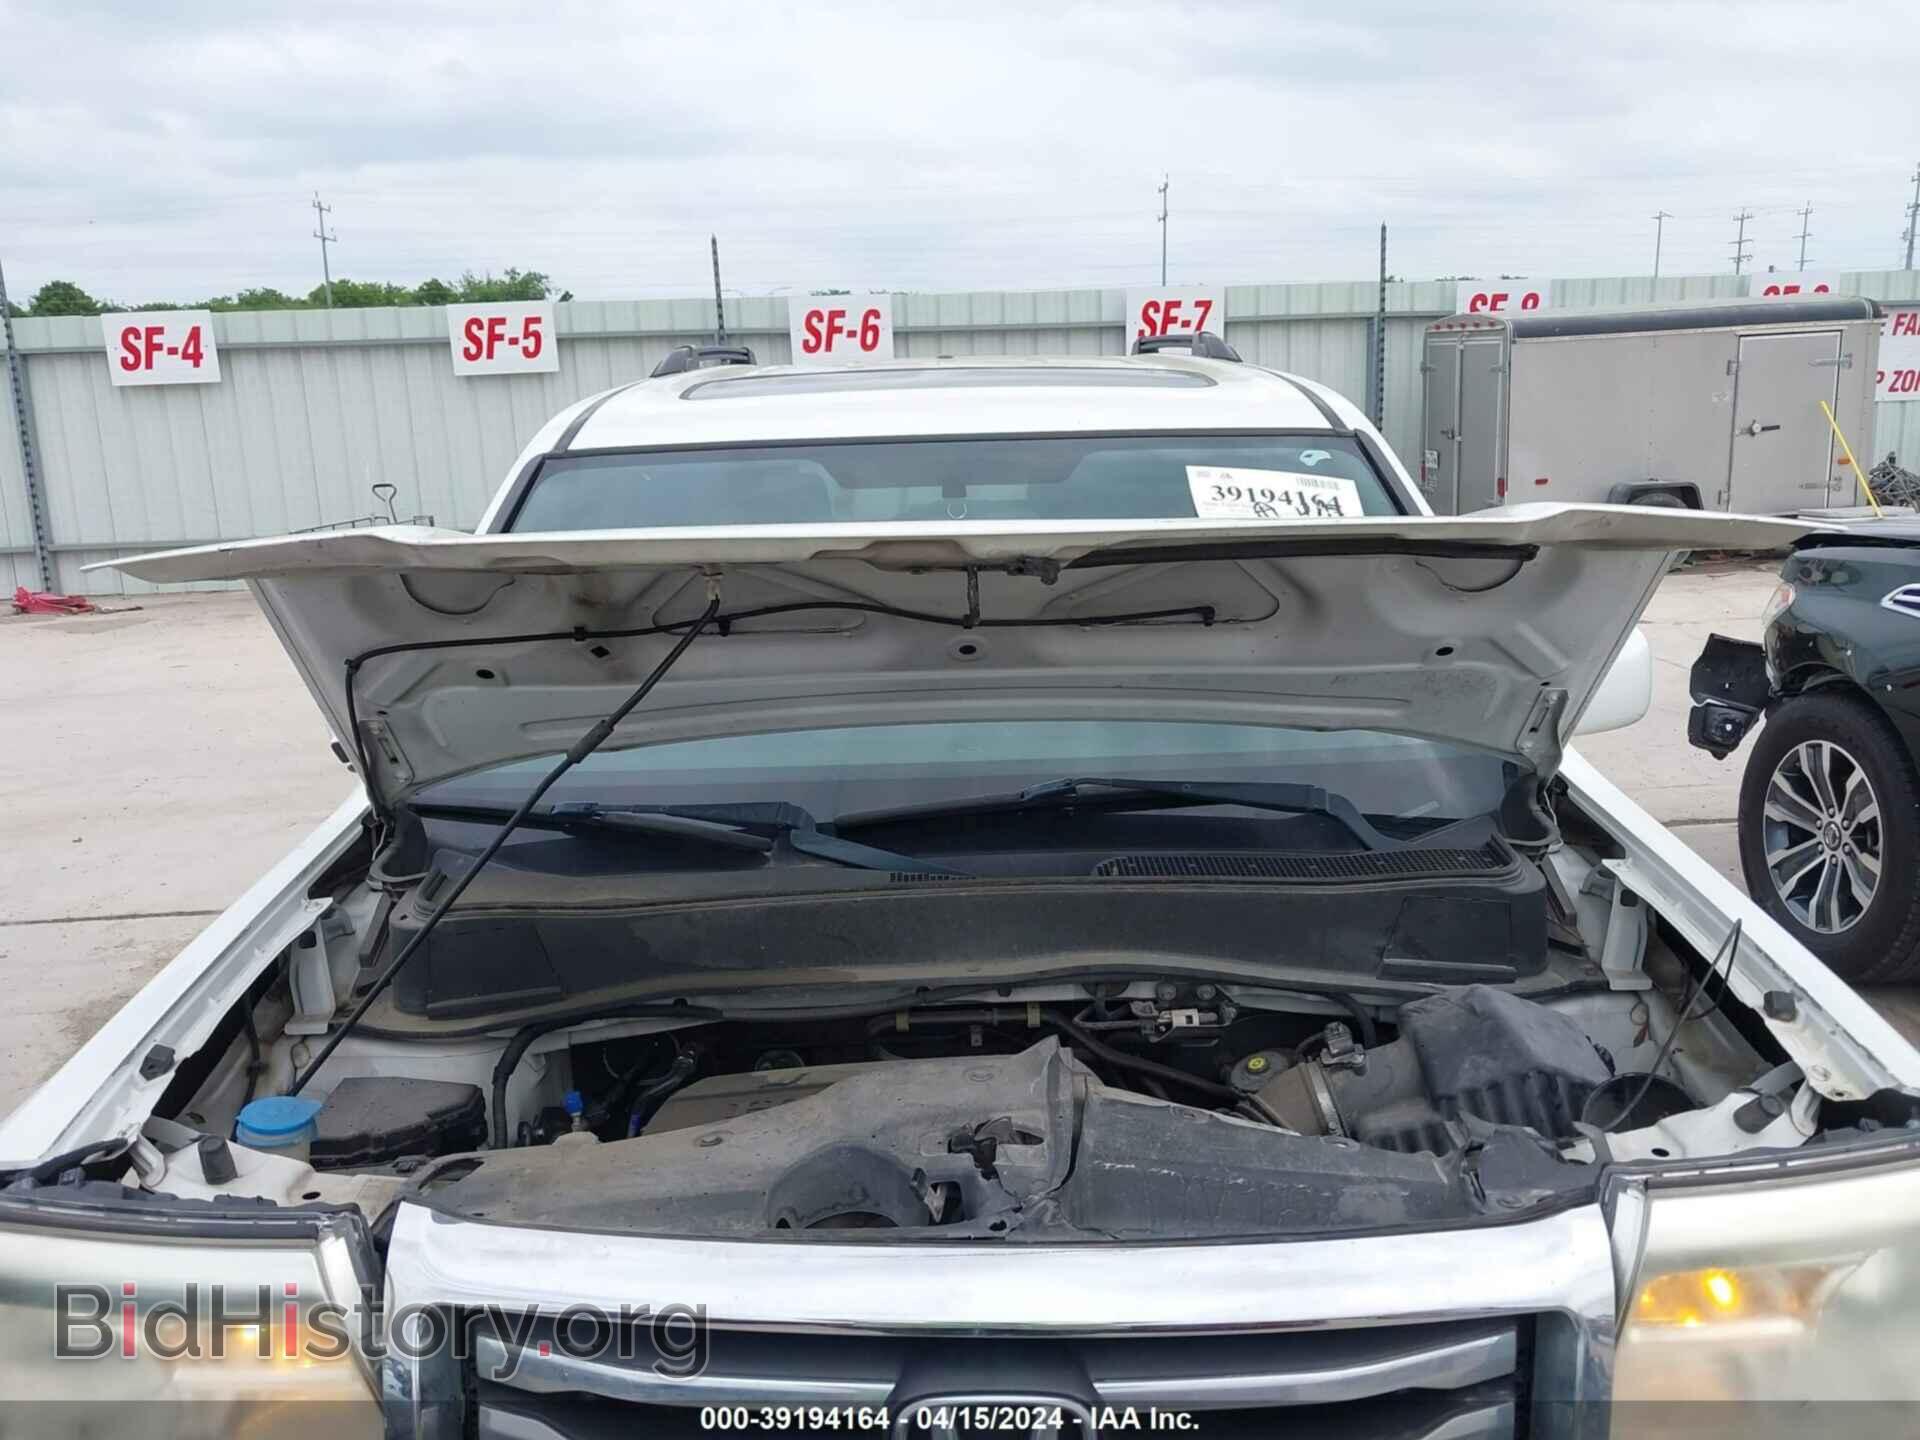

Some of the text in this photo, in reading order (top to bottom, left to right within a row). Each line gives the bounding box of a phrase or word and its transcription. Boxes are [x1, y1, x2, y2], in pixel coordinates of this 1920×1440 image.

[462, 315, 543, 362] SF-5
[801, 307, 881, 354] SF-6
[1137, 299, 1213, 337] SF-7
[1892, 312, 1920, 336] FA
[120, 324, 204, 372] SF-4
